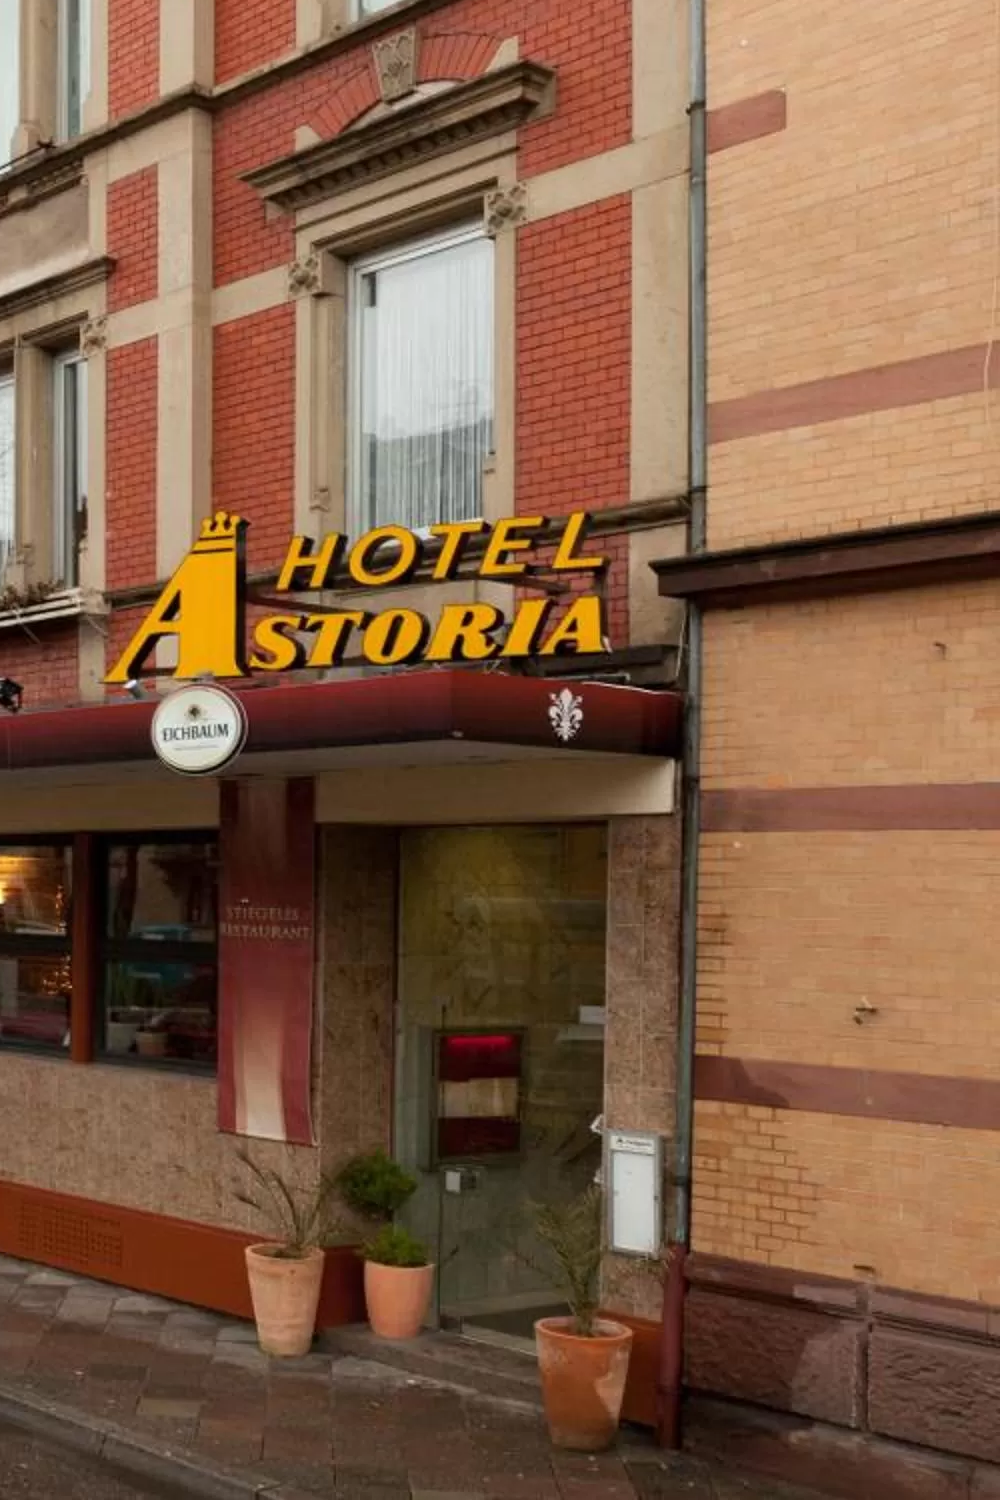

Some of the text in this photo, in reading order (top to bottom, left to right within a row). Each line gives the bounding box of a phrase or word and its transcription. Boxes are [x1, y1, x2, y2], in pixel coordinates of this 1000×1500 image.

[276, 512, 606, 592] HOTEL
[103, 512, 608, 683] ASTORIA
[162, 723, 230, 742] EICHBAUM
